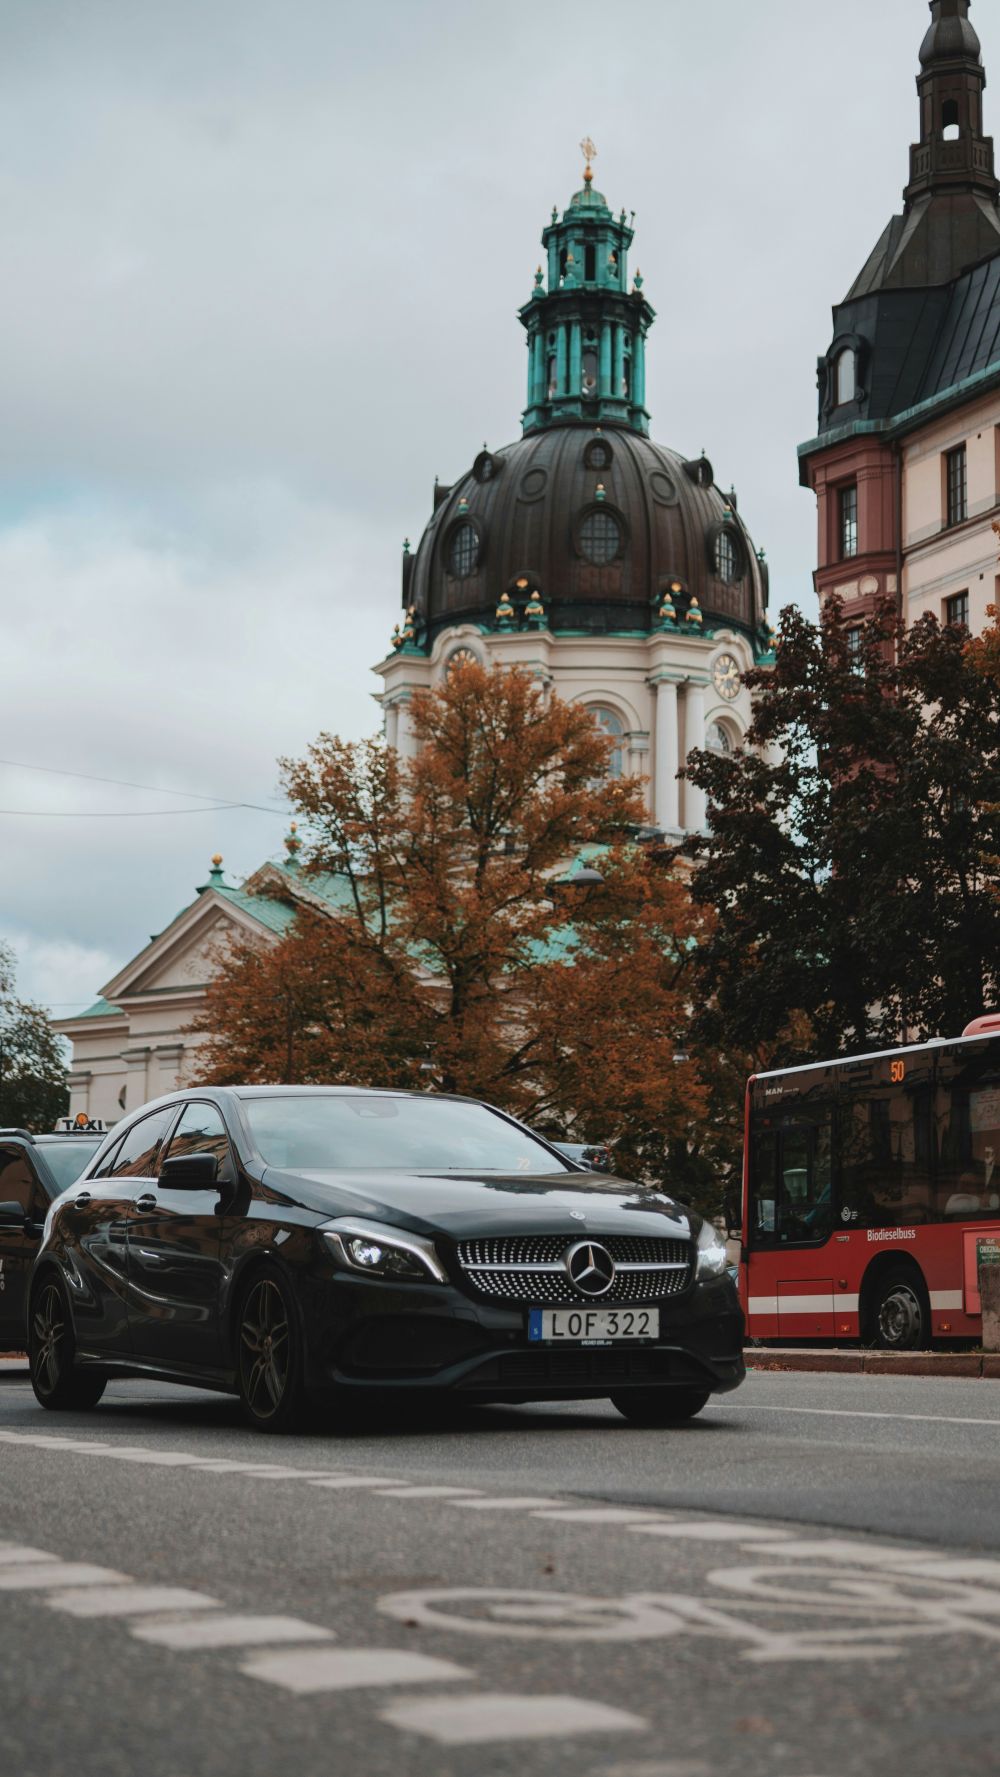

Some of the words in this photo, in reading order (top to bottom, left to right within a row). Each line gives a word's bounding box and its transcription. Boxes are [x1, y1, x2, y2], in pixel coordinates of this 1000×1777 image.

[890, 1061, 905, 1082] 50
[765, 1087, 783, 1097] MAN
[61, 1119, 103, 1131] TAXI
[867, 1228, 916, 1242] Biodieselbuss
[552, 1312, 598, 1337] LOF
[606, 1311, 650, 1336] 322
[533, 1327, 539, 1335] S
